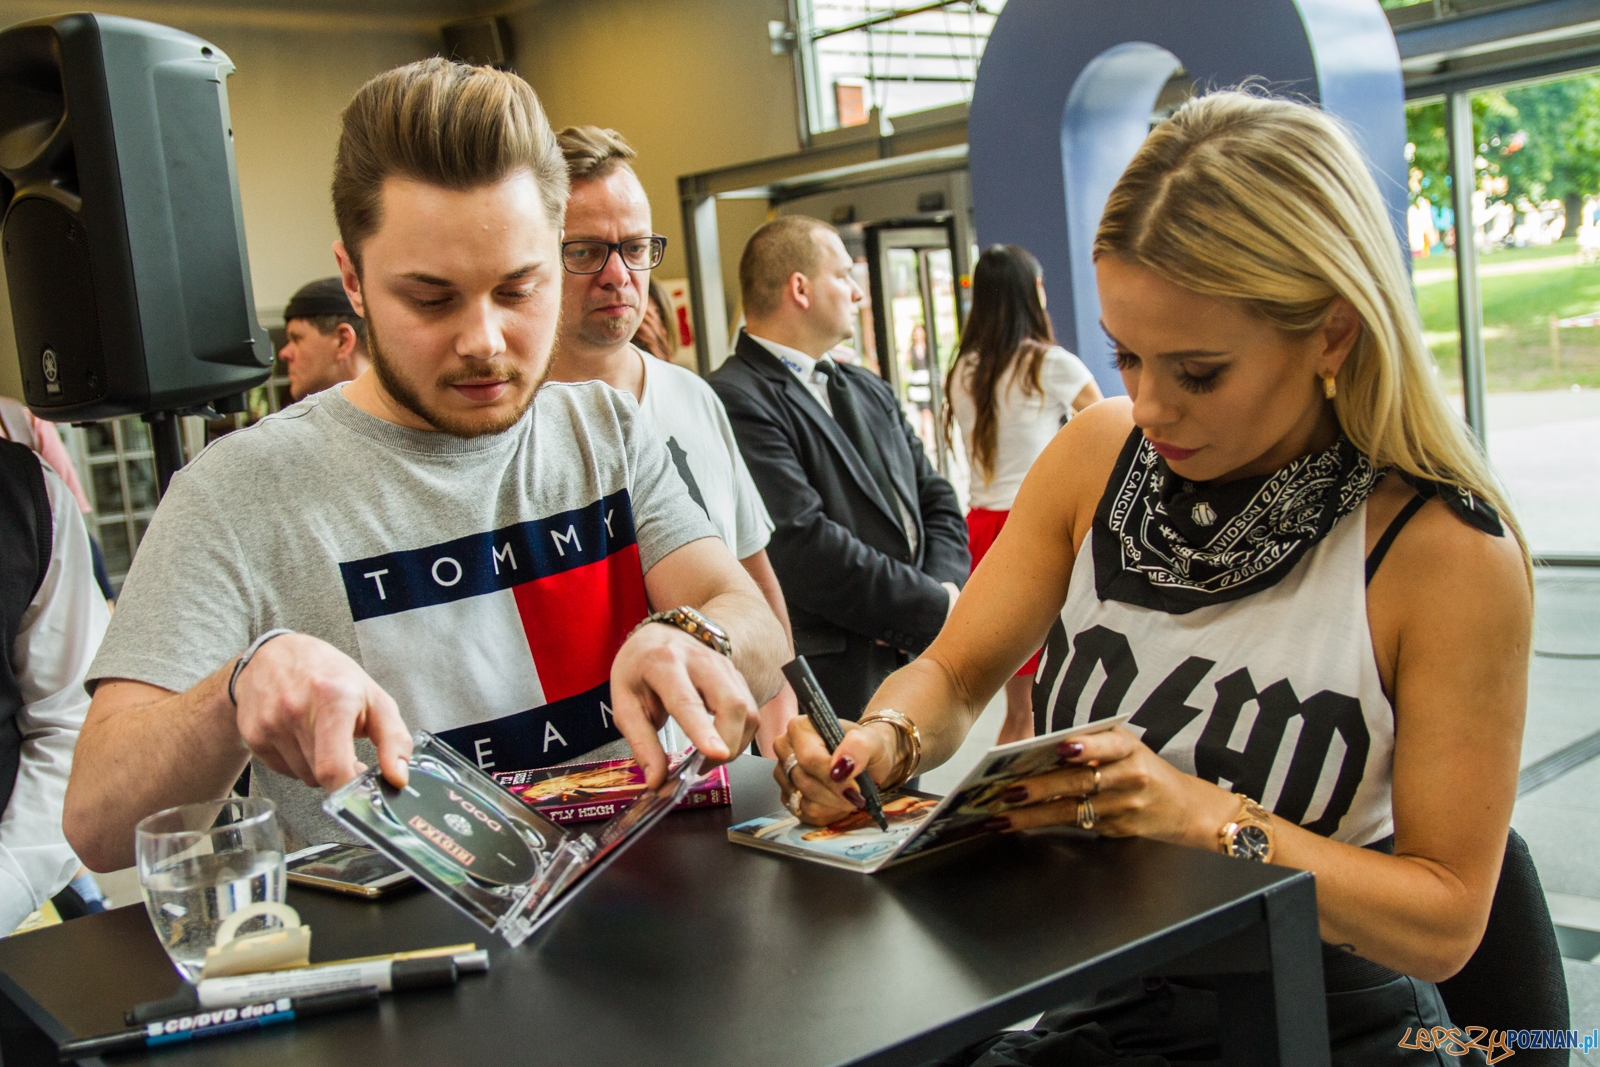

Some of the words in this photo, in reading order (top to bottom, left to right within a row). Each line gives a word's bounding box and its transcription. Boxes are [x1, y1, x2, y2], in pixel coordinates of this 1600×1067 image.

[1111, 471, 1141, 531] CANCUN
[1213, 505, 1262, 554] AVIDSON
[364, 509, 614, 600] TOMMY
[449, 789, 502, 832] DODA
[550, 809, 575, 821] FLY
[578, 804, 615, 818] HIGH
[166, 1009, 237, 1032] CD/DVD
[241, 1004, 275, 1019] duo
